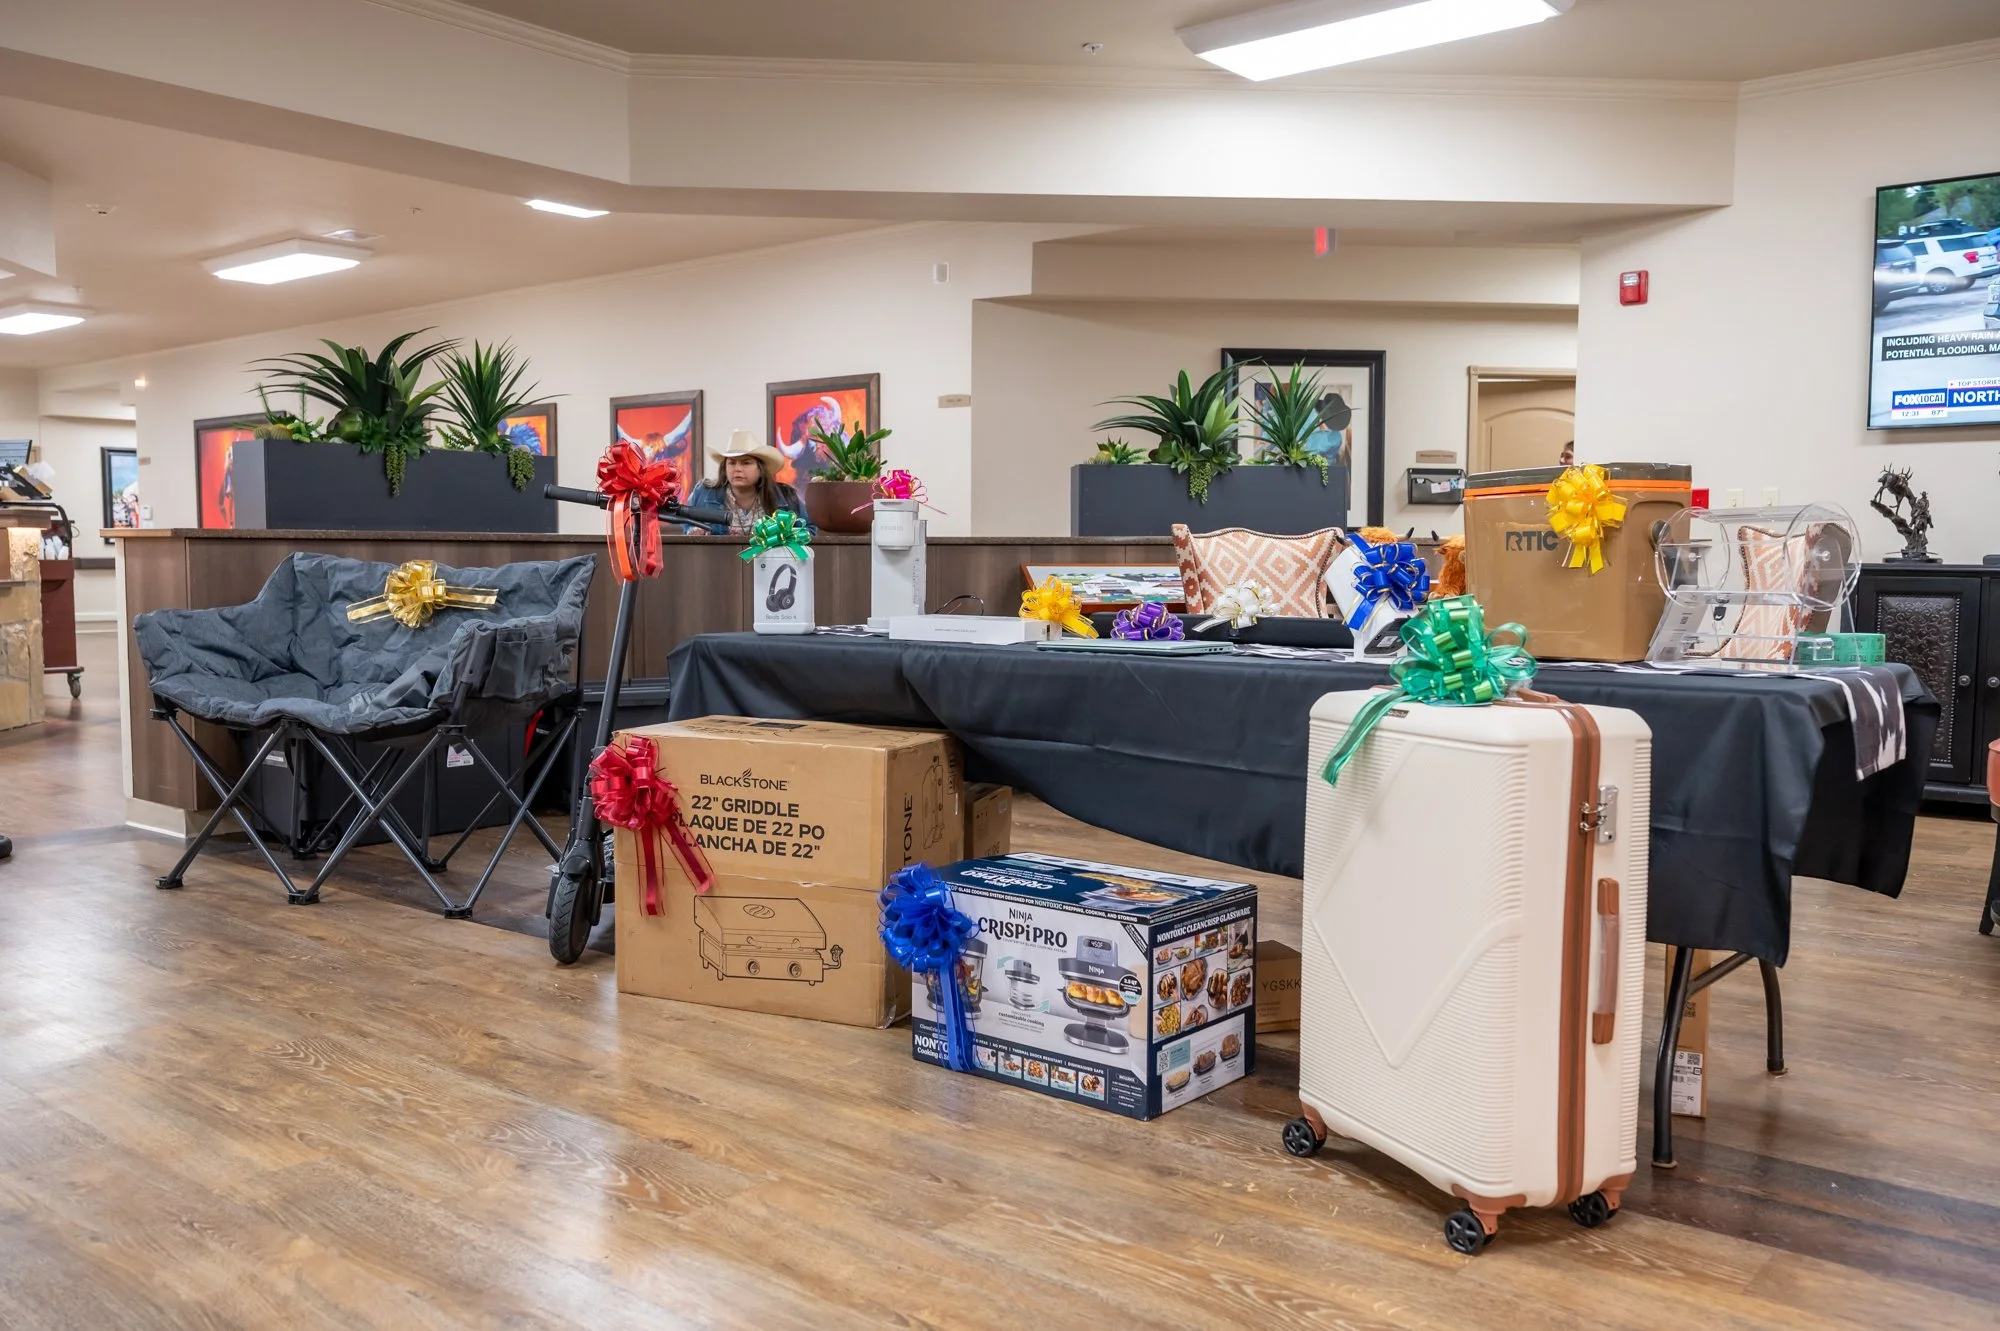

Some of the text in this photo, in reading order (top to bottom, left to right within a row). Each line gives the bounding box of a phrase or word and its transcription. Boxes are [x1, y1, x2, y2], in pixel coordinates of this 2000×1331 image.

[1886, 336, 1935, 347] INCLUDING
[1937, 333, 1969, 343] HEAVY
[1971, 331, 1993, 341] RAIN
[1886, 348, 1935, 359] POTENTIAL
[1937, 345, 1987, 356] FLOODING.
[1894, 393, 1919, 406] FOX
[1505, 530, 1558, 551] RTIC
[700, 774, 788, 791] BLACKSTONE
[691, 795, 800, 818] 22" GRIDDLE
[743, 818, 767, 835] DE
[772, 821, 793, 837] 22
[799, 823, 825, 840] PO
[762, 840, 787, 856] DE
[791, 843, 820, 859] 22"
[972, 889, 989, 897] COOKING
[1005, 895, 1026, 903] DESIGNED
[1034, 899, 1063, 910] NONTOXIC
[1117, 914, 1138, 922] STORING
[1009, 907, 1033, 923] NINJA
[1157, 926, 1187, 943] NONTOXIC
[1219, 907, 1251, 923] GLASSWARE
[1032, 927, 1068, 948] PRO
[1088, 965, 1105, 975] NINJA
[914, 1034, 949, 1053] NONTO
[917, 1046, 938, 1059] Cooking
